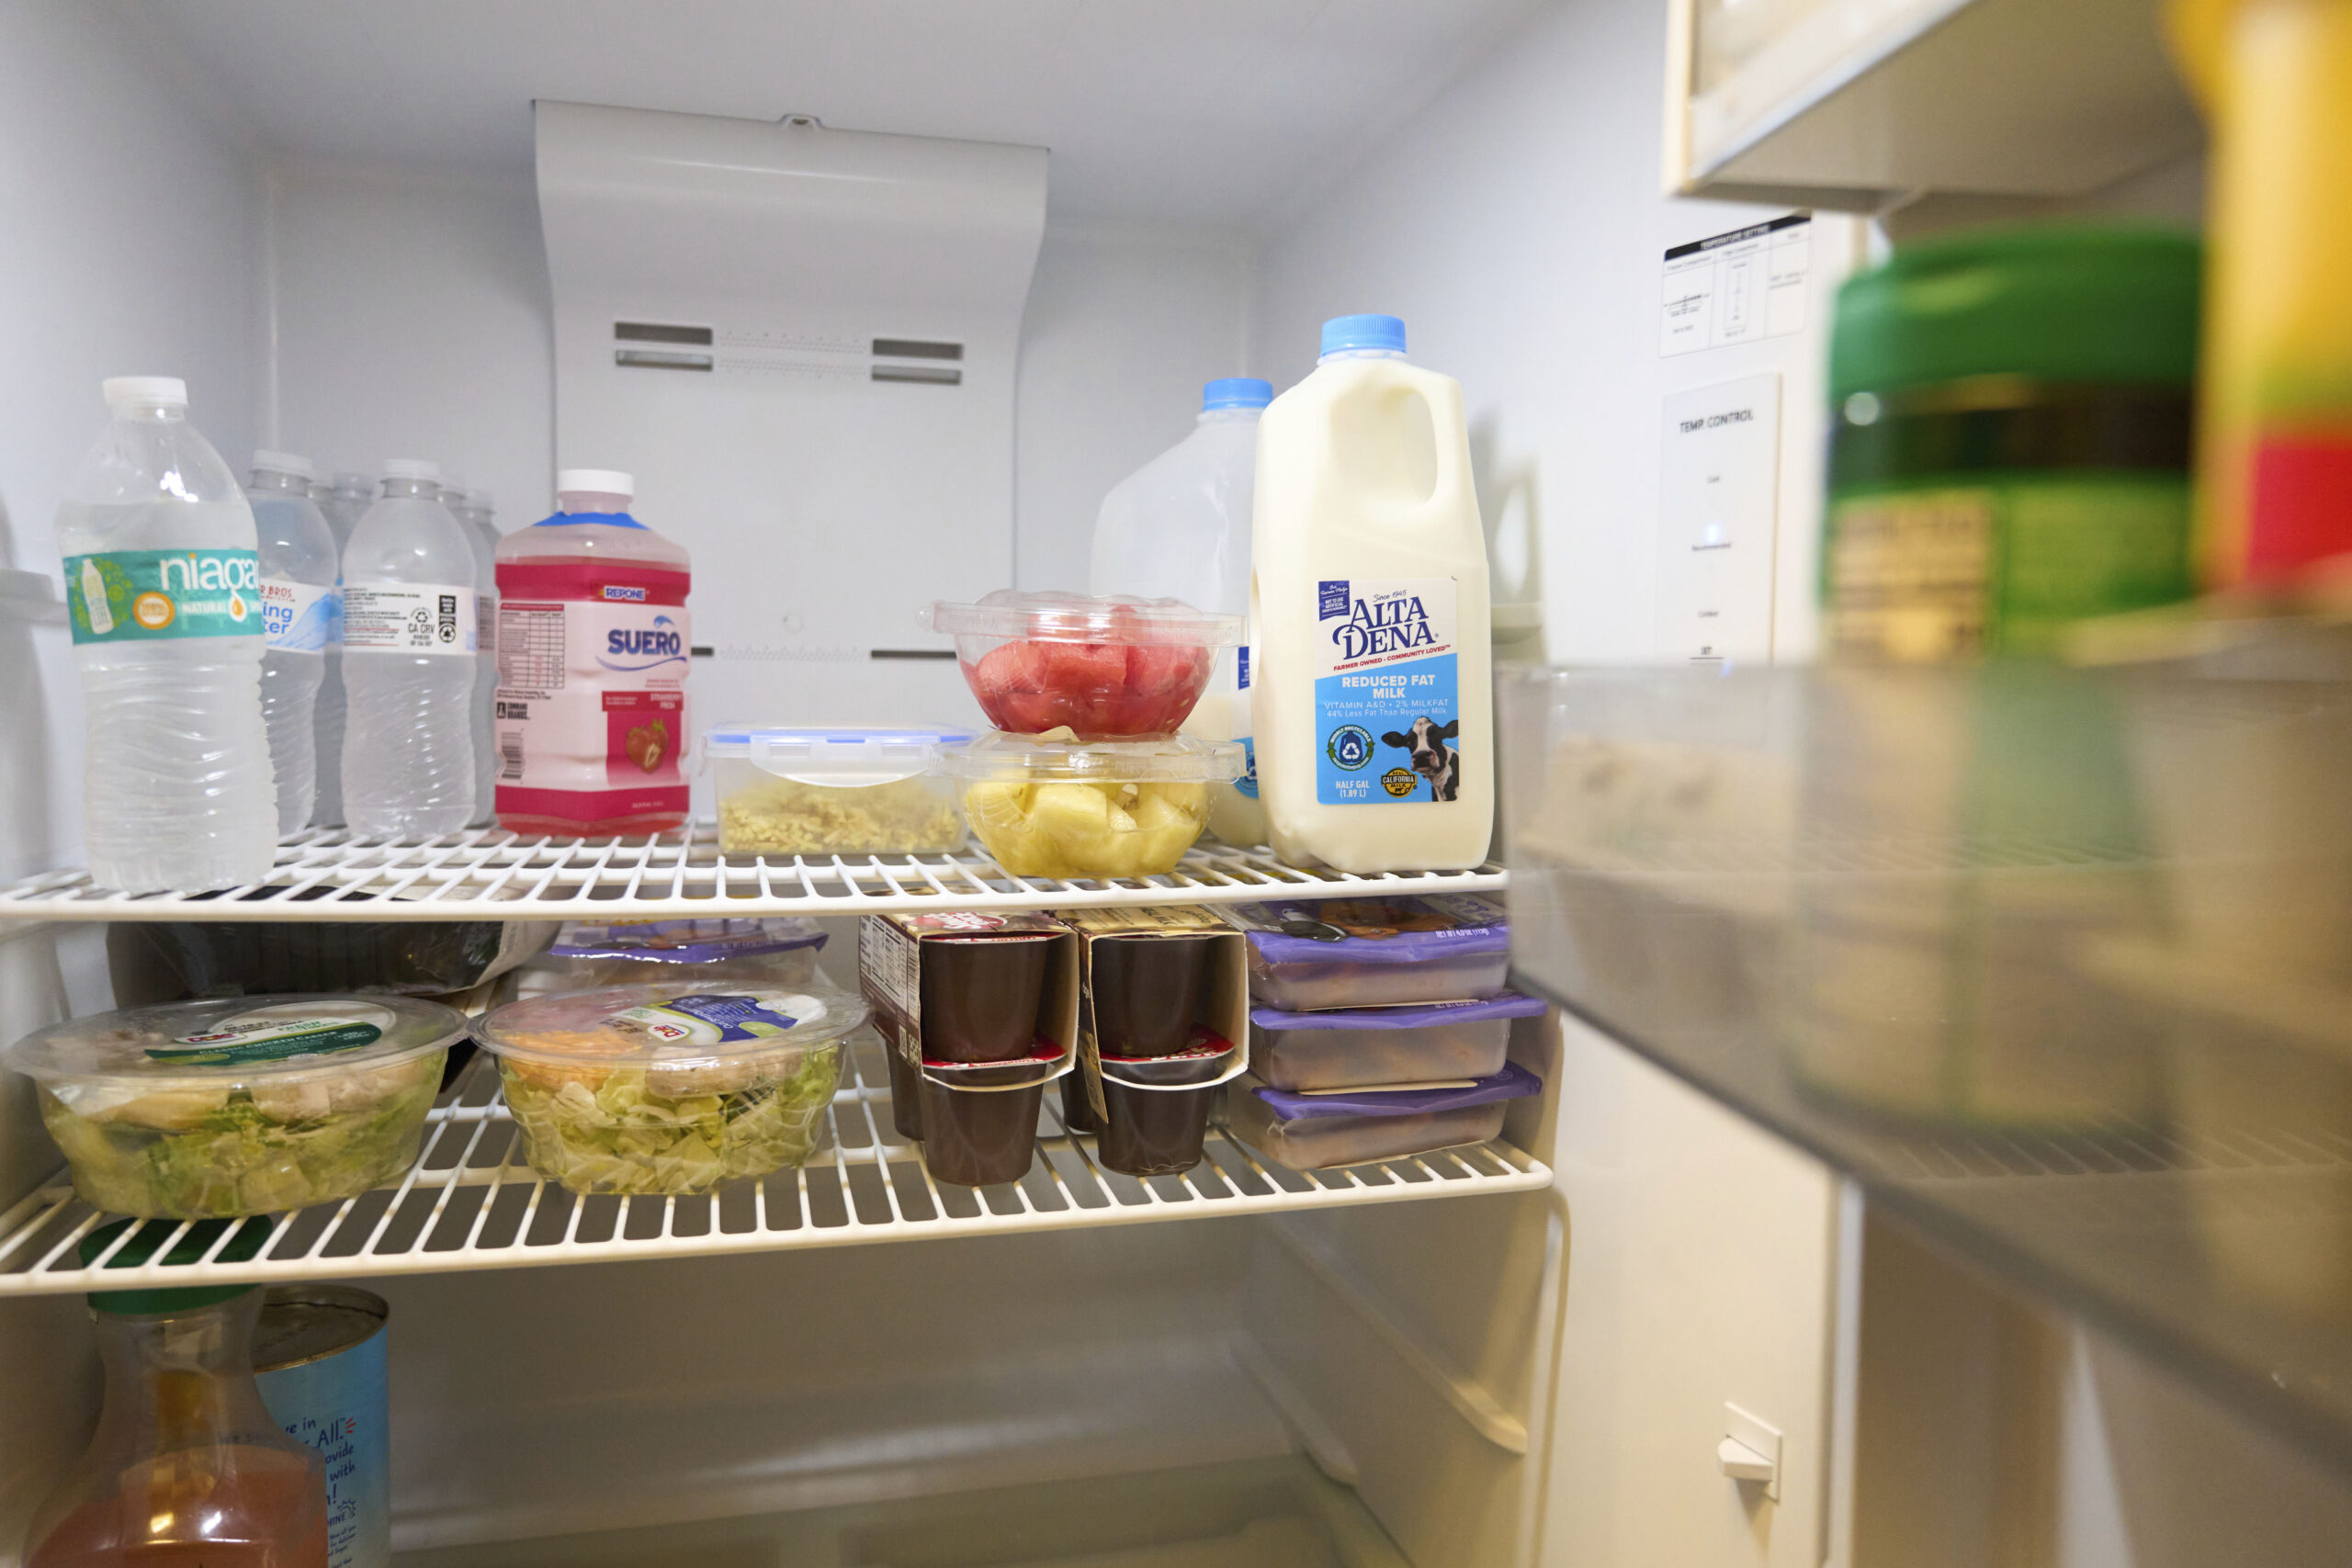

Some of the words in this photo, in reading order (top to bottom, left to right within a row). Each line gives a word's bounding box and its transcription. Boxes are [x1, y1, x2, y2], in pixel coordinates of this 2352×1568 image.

[1707, 409, 1754, 429] CONTROL
[160, 552, 259, 617] niaga
[605, 588, 645, 600] REPONE
[1373, 593, 1391, 603] Since
[1392, 590, 1408, 598] 1945
[185, 601, 229, 614] NATURAL
[1346, 596, 1429, 633] ALTA
[409, 623, 418, 634] CA
[421, 624, 435, 635] CRV
[608, 629, 681, 656] SUERO
[1332, 621, 1436, 660] DENA
[1333, 662, 1359, 671] FARMER
[1359, 658, 1383, 667] OWNED
[1386, 649, 1425, 661] COMMUNITY
[1342, 675, 1408, 688] REDUCED
[1411, 674, 1435, 686] FAT
[1373, 688, 1406, 699] MILK
[1324, 701, 1363, 710] VITAMIN
[1366, 700, 1385, 708] A&D
[1411, 699, 1449, 707] MILKFAT
[1400, 708, 1429, 716] Regular
[1356, 780, 1370, 788] GAL
[187, 1033, 235, 1043] Dole
[246, 1038, 295, 1047] CHICKEN
[302, 1418, 317, 1431] in
[330, 1461, 356, 1482] with
